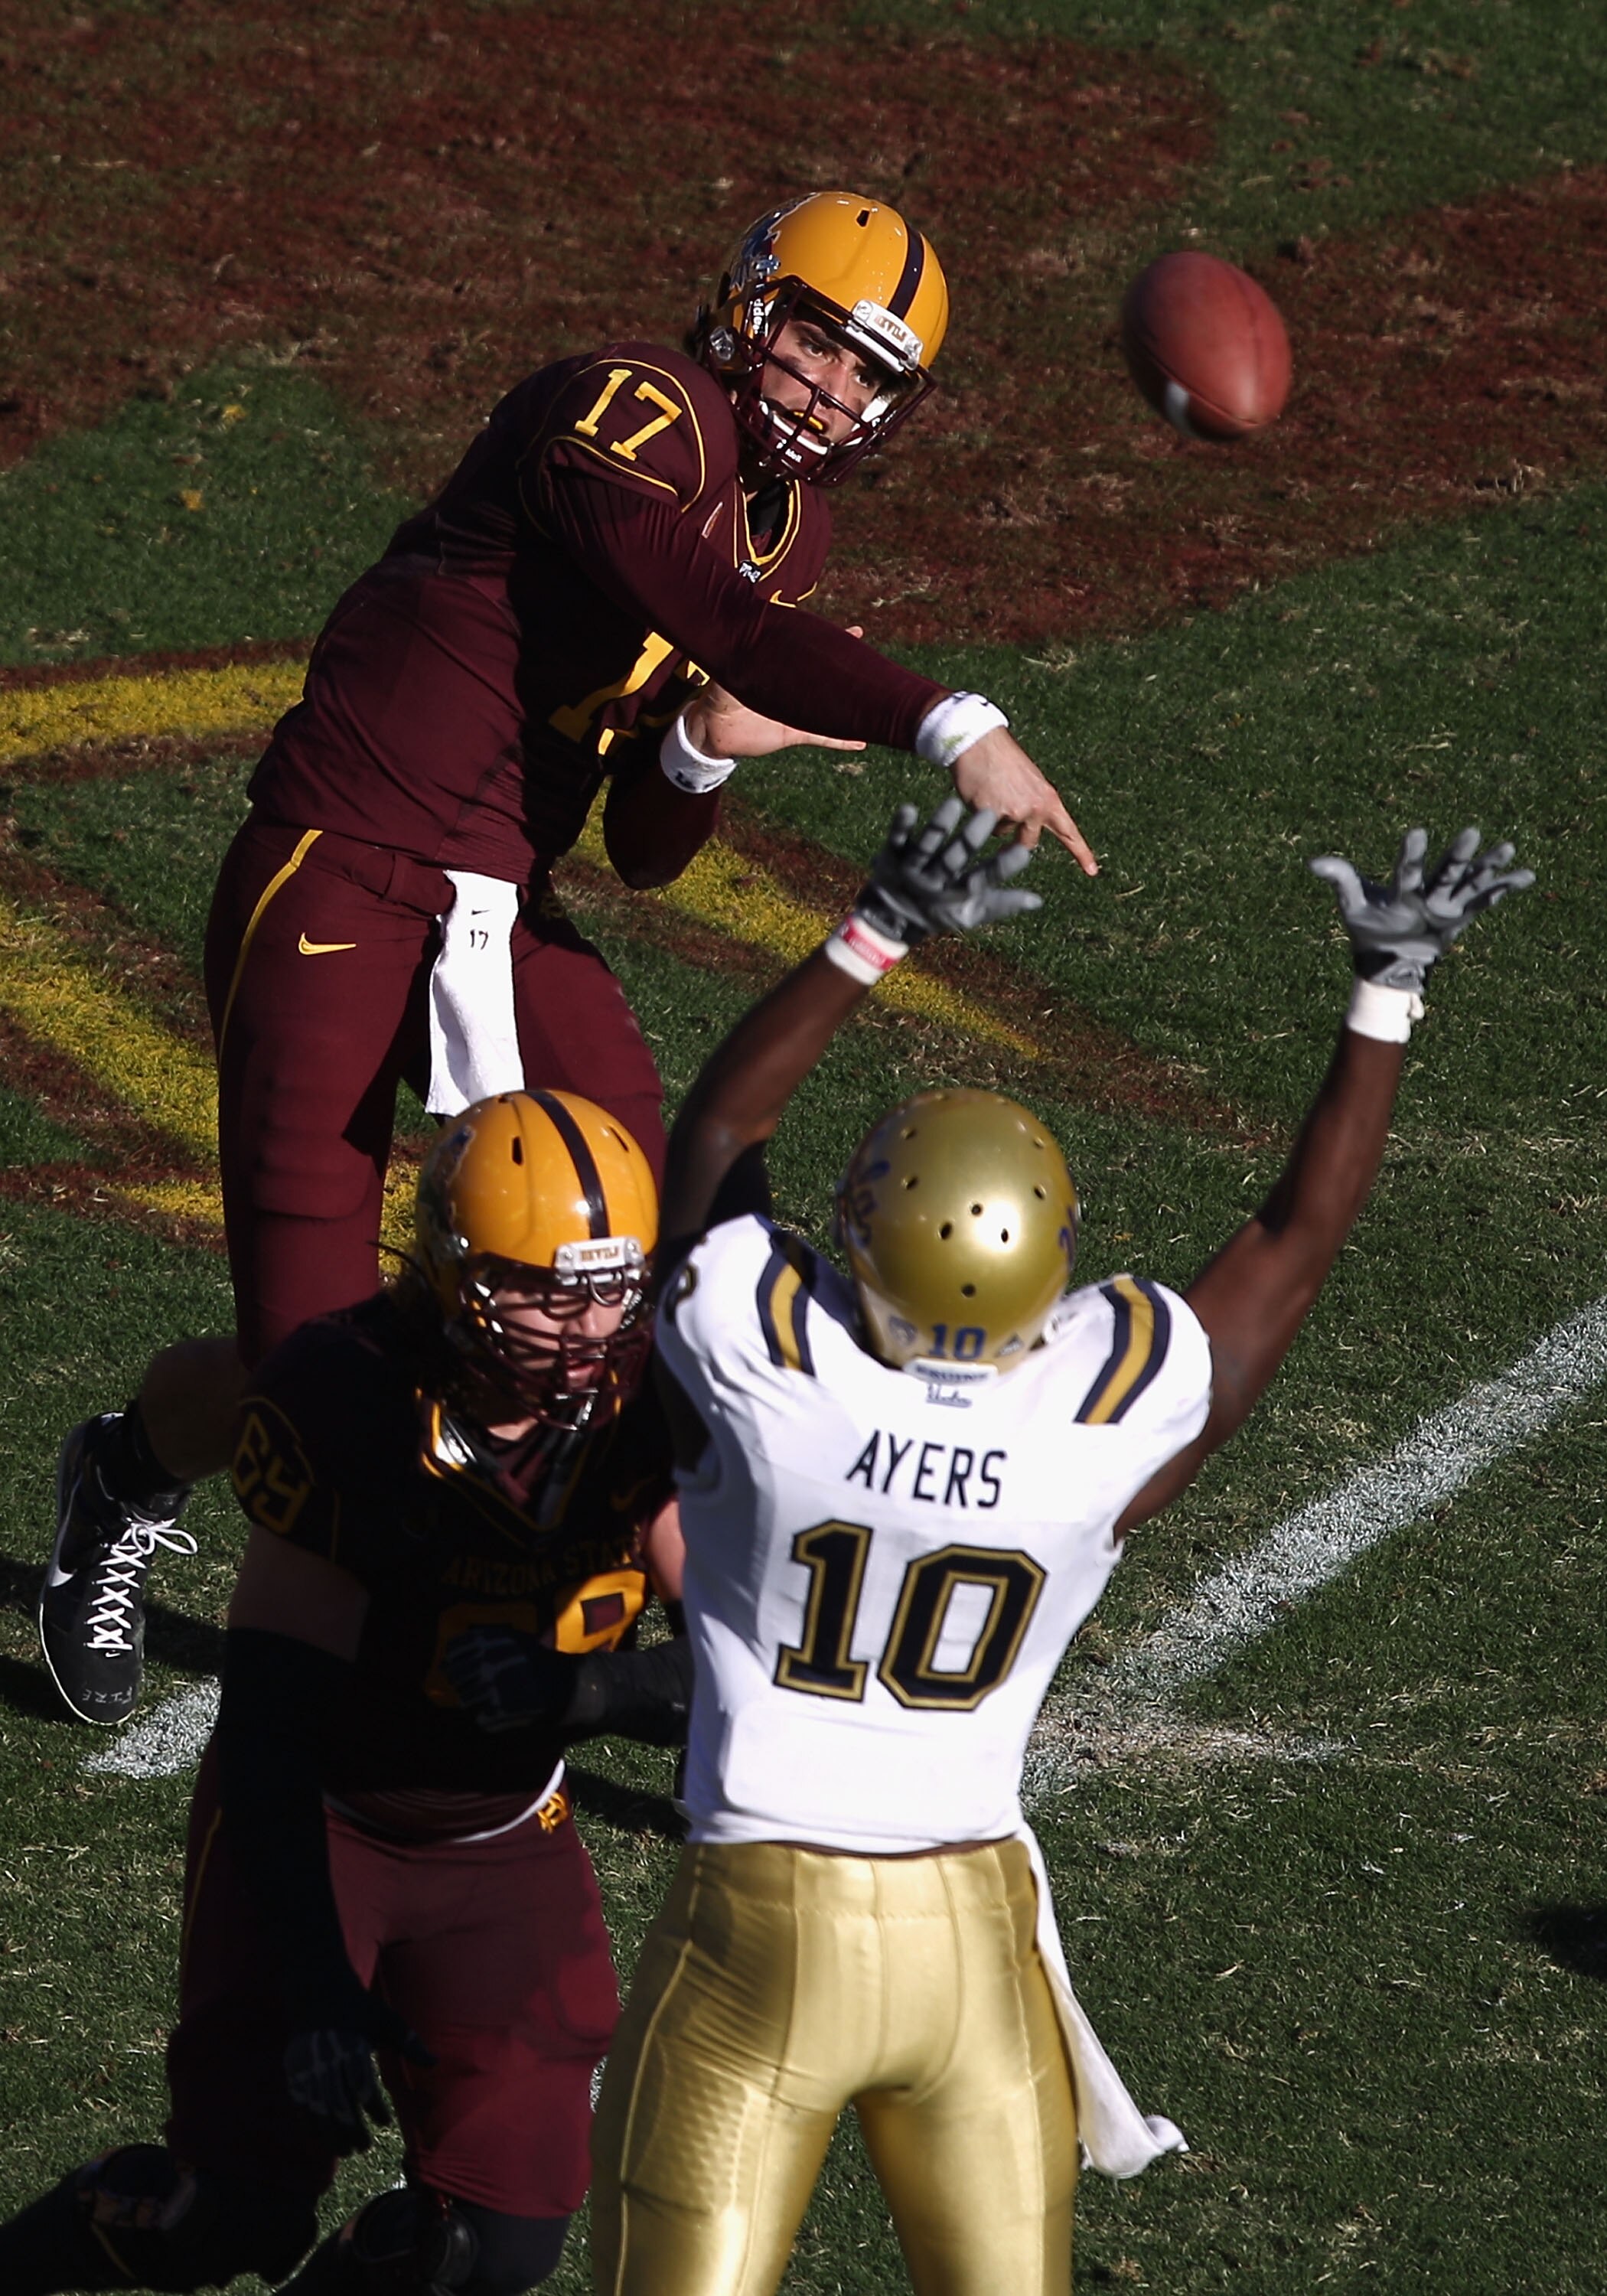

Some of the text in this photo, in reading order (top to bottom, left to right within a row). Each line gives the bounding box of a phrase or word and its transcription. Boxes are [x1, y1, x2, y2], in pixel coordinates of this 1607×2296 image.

[575, 369, 683, 461] 17
[469, 928, 489, 951] 17
[927, 1323, 987, 1361] 10
[846, 1430, 1008, 1508] AYERS
[441, 1555, 557, 1596] ARIZONA
[773, 1518, 1048, 1713] 10
